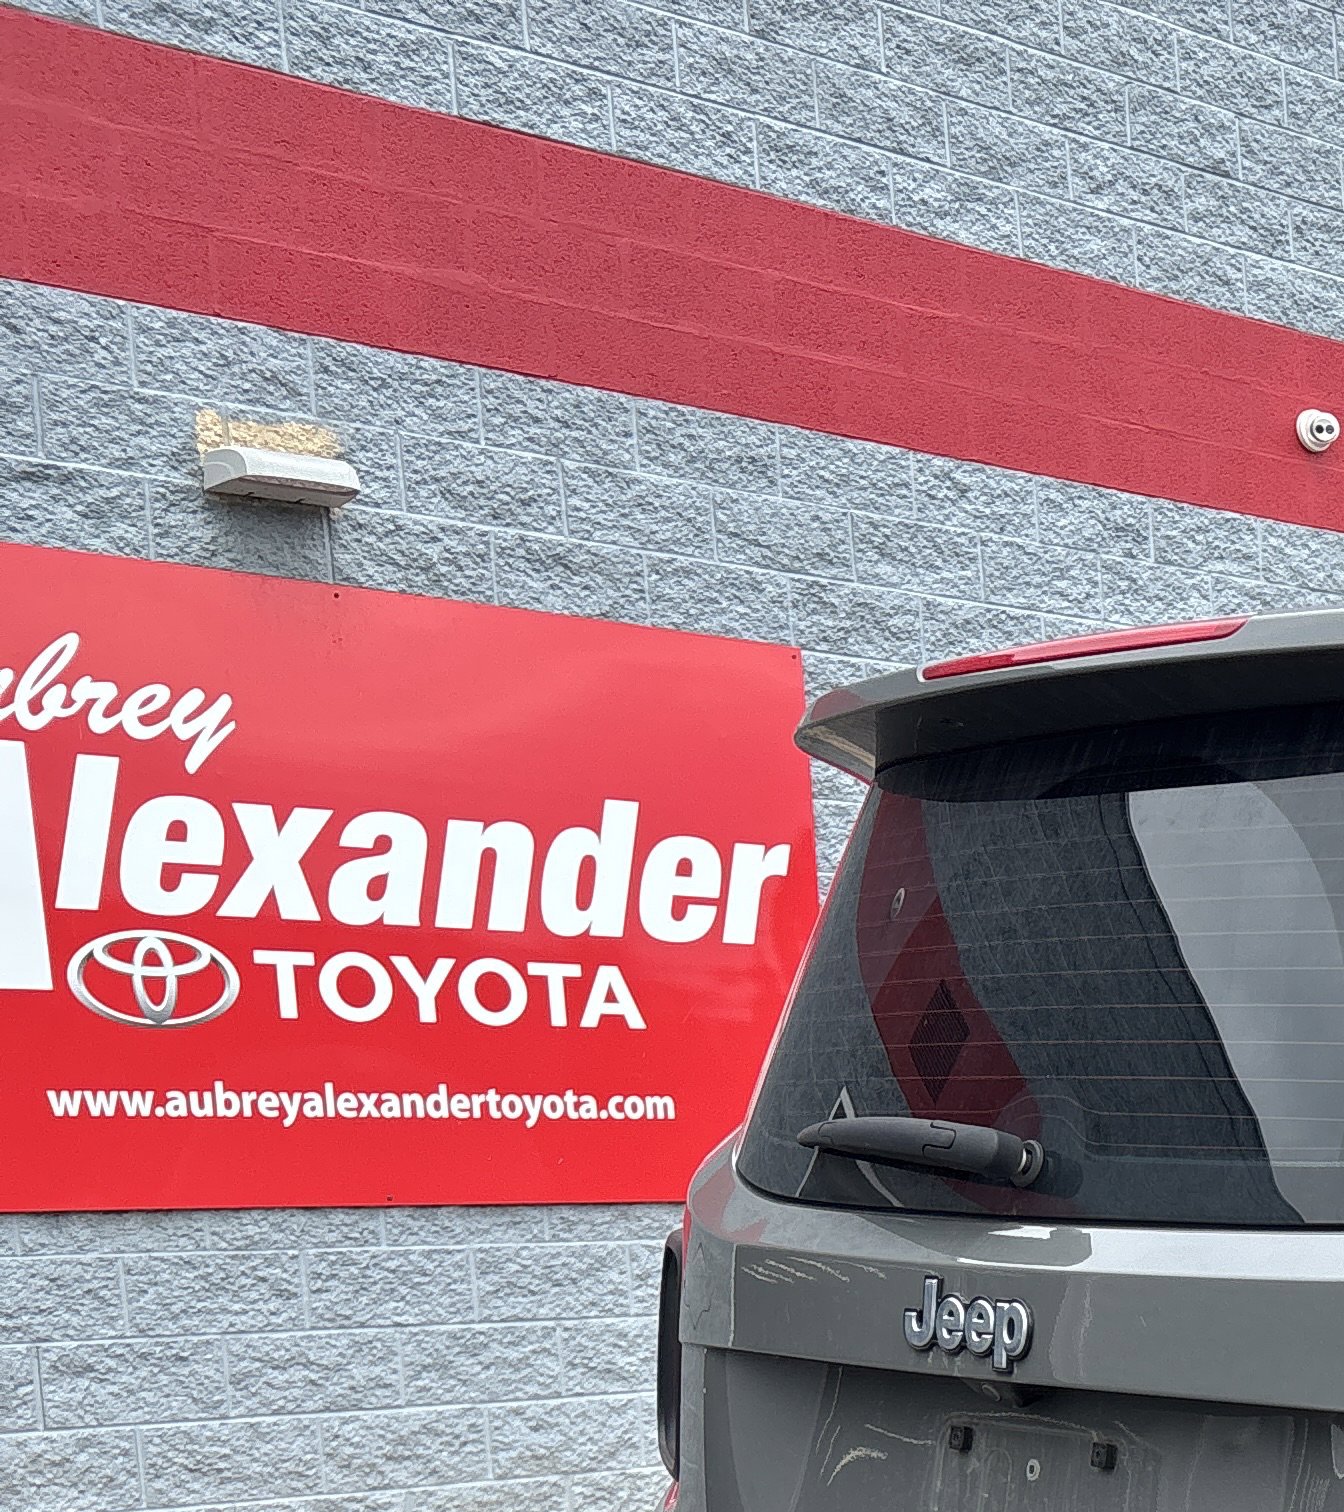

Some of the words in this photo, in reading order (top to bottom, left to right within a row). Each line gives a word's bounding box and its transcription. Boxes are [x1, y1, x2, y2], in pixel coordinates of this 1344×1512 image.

[253, 950, 647, 1030] TOYOTA
[46, 1080, 676, 1128] www.aubreyalexandertoyota.com
[903, 1274, 1034, 1373] Jeep
